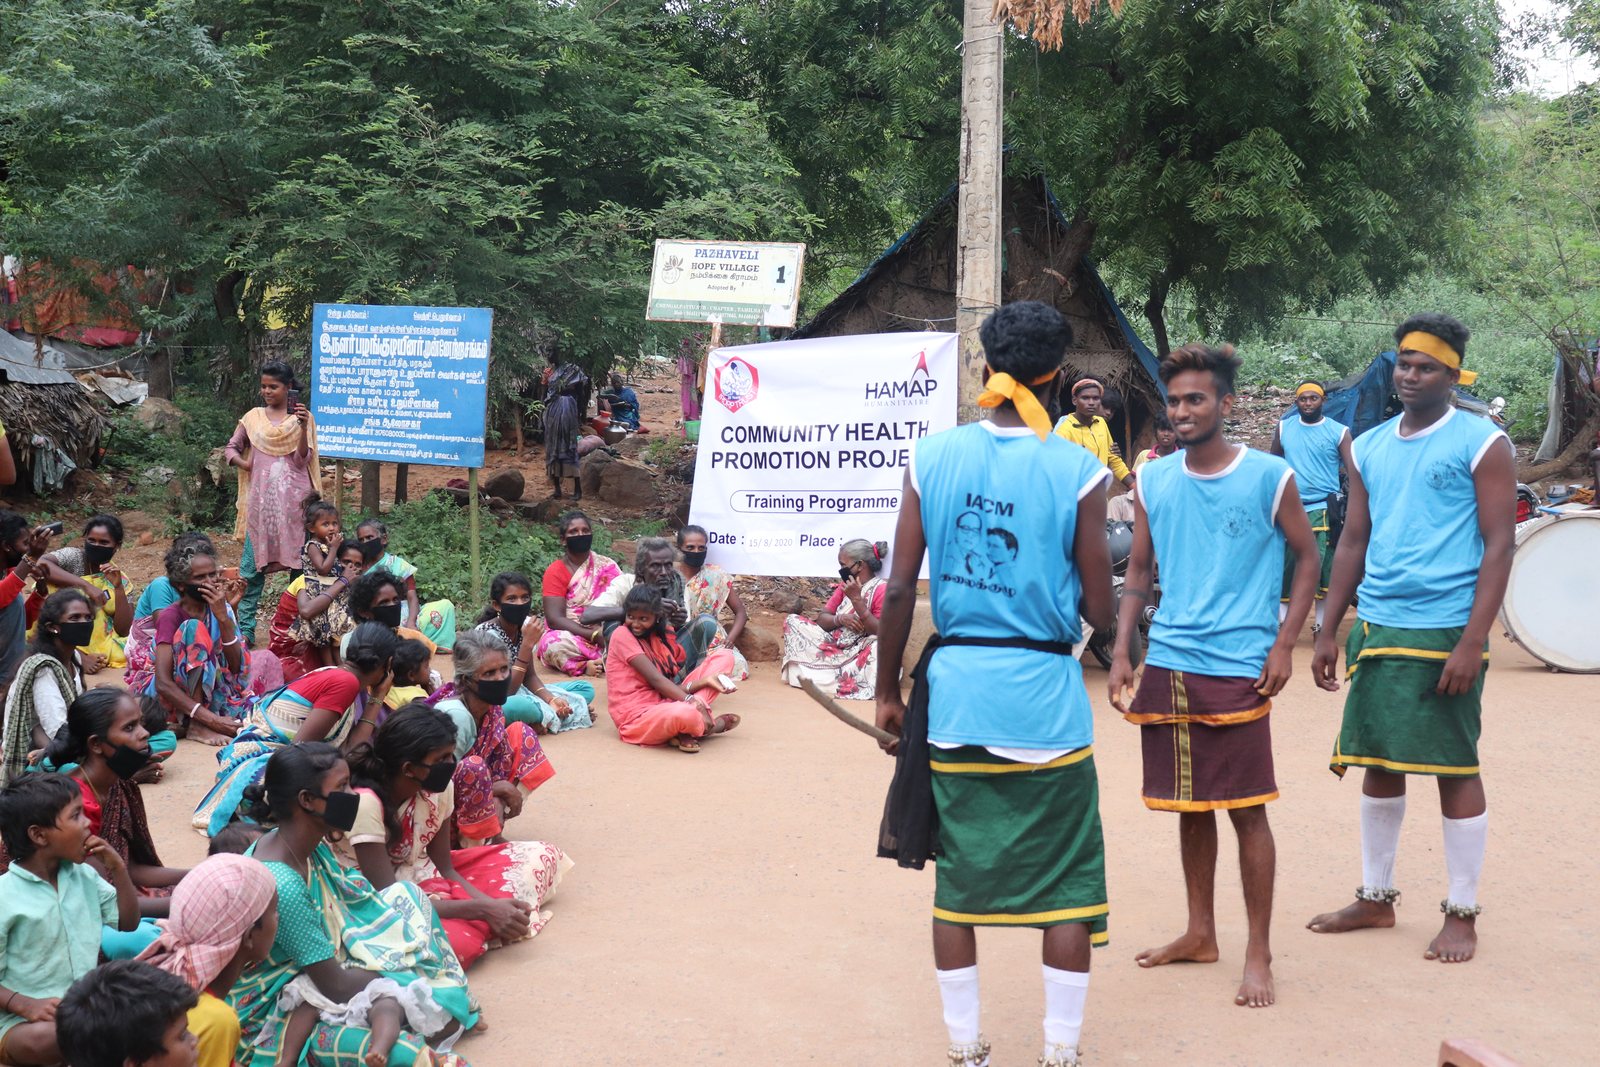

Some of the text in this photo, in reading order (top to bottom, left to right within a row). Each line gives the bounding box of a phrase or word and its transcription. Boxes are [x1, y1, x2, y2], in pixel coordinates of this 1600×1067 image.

[694, 248, 759, 260] PAZHAVELI
[691, 262, 760, 272] HOPE VILLAGE
[775, 265, 786, 284] 1
[865, 379, 938, 400] HAMAP
[864, 399, 929, 407] HUMANITAIRE
[720, 420, 930, 444] COMMUNITY HEALTH
[711, 449, 909, 470] PROMOTION PROJE
[745, 494, 898, 512] Training Programme
[965, 492, 1014, 517] IACM
[709, 531, 737, 544] Date
[799, 534, 835, 547] Place
[940, 573, 1016, 598] கலைக்குழு
